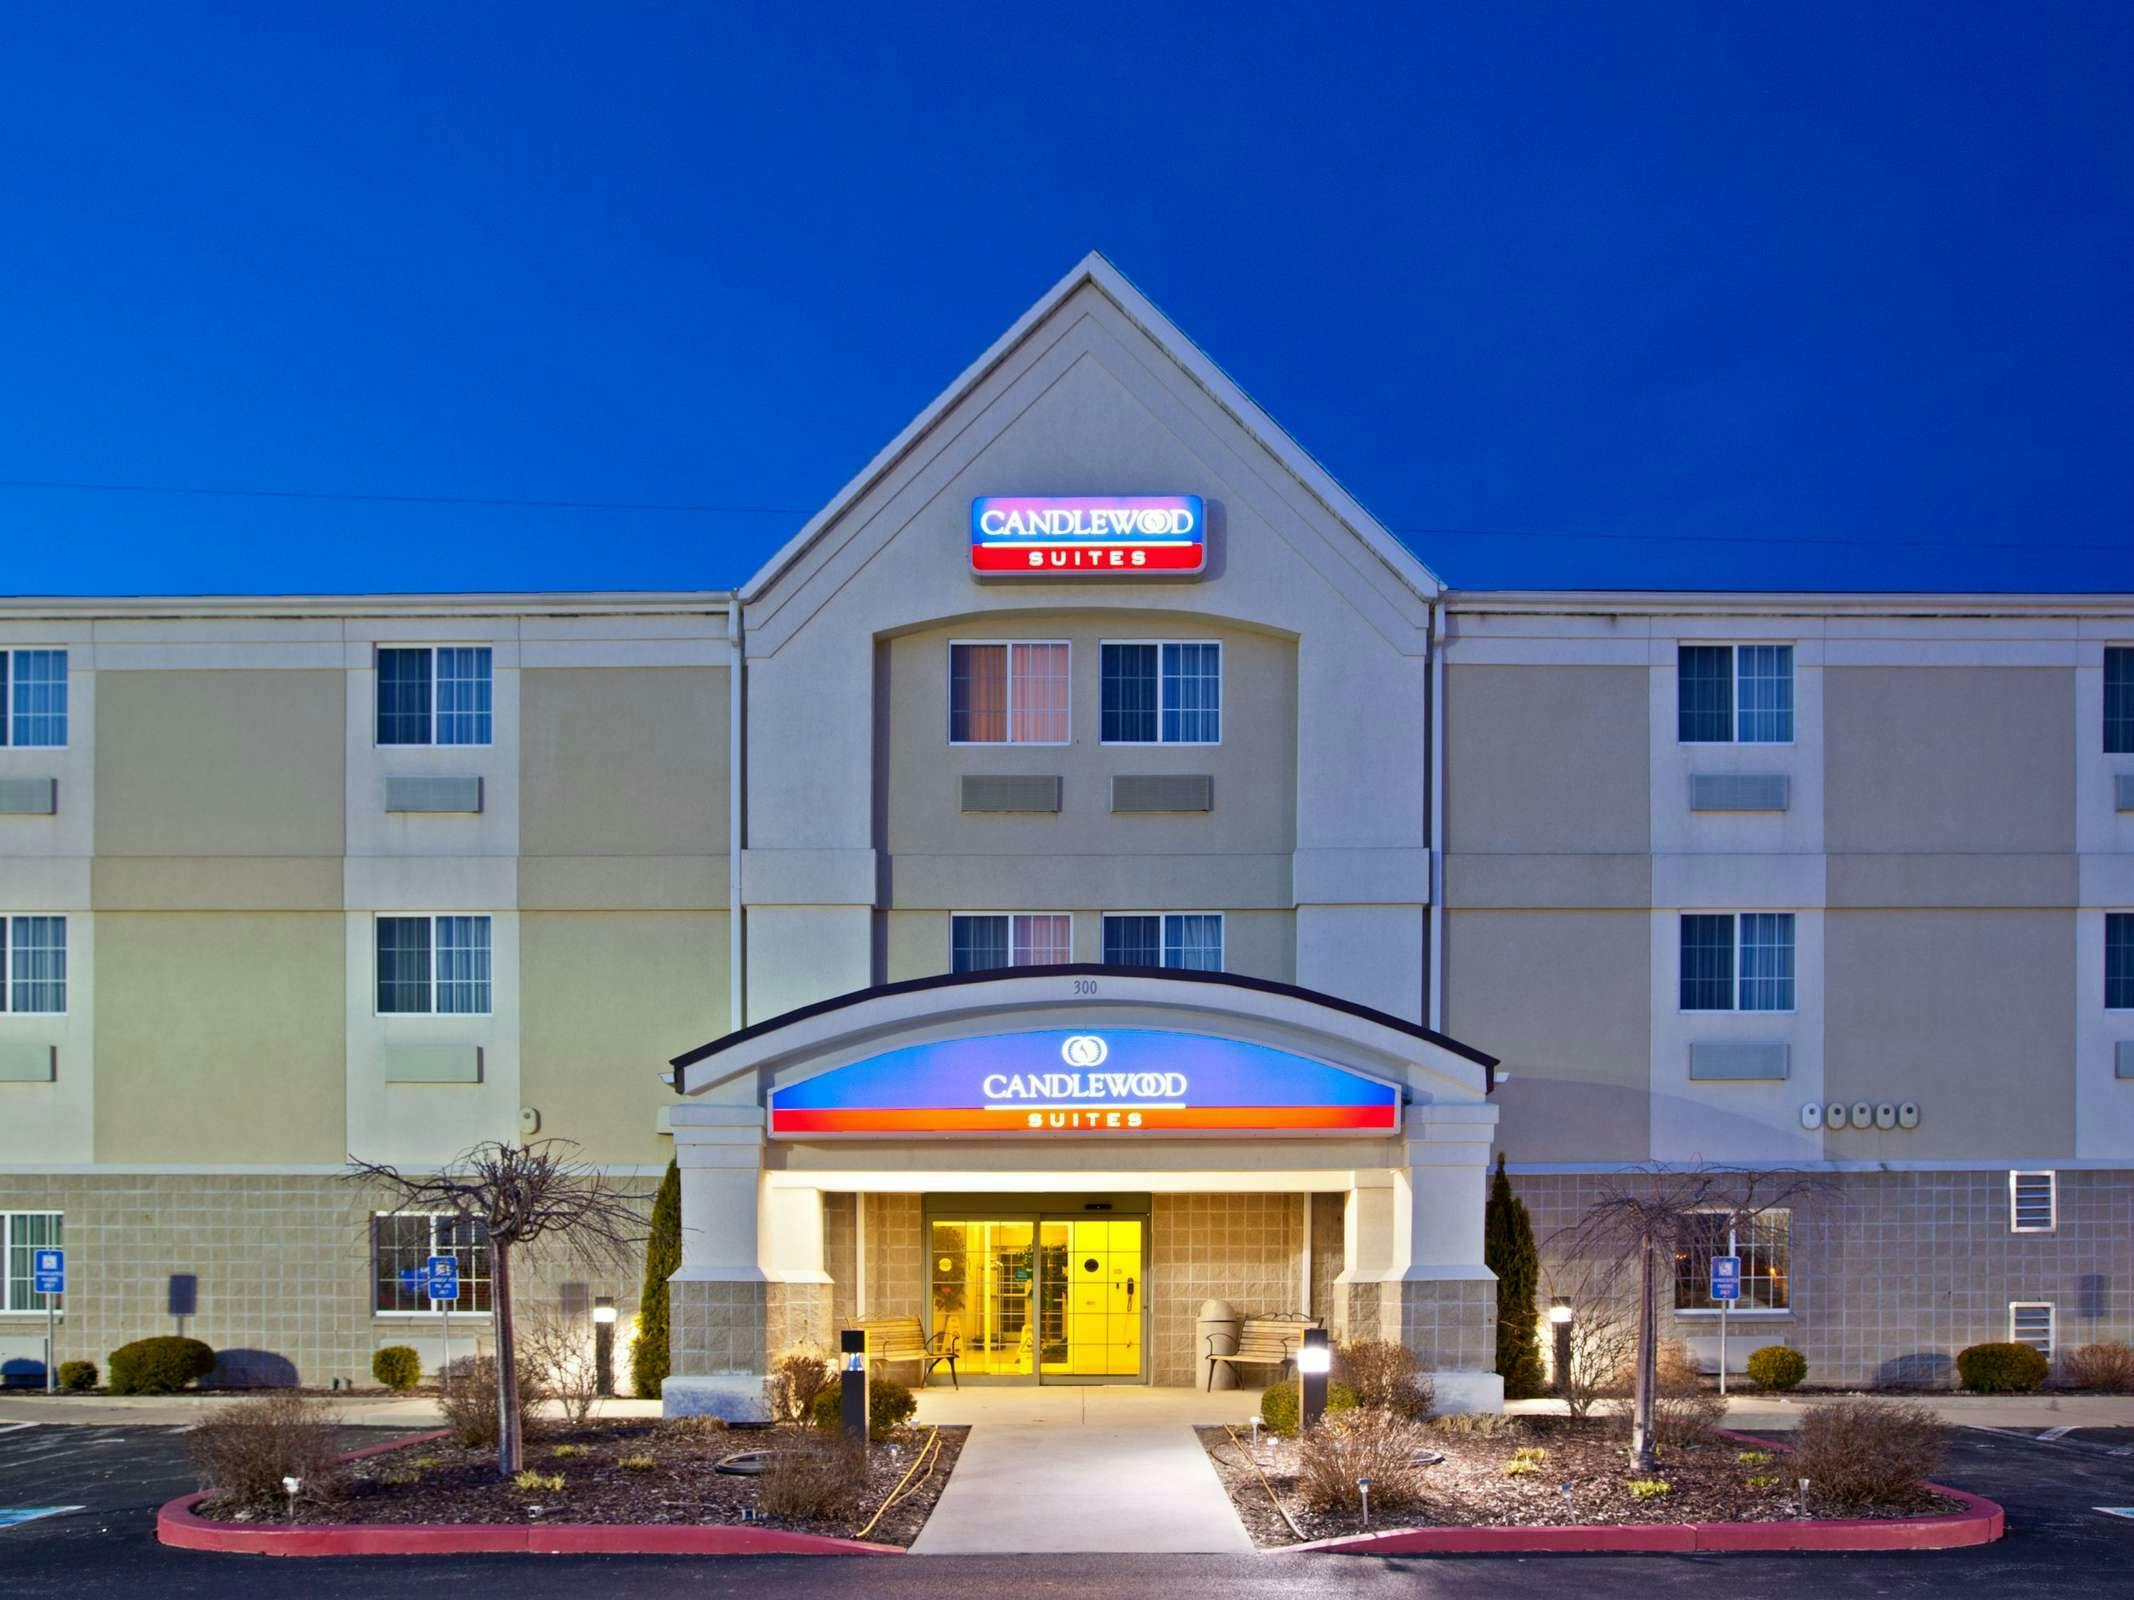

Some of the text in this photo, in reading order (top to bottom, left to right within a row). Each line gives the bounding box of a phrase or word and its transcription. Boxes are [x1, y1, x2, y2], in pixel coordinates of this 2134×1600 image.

[980, 509, 1193, 535] CANDLEWOOD
[1028, 551, 1146, 566] SUITES
[1073, 980, 1098, 995] 300
[983, 1072, 1187, 1098] CANDLEWOOD
[1028, 1113, 1142, 1127] SUITES
